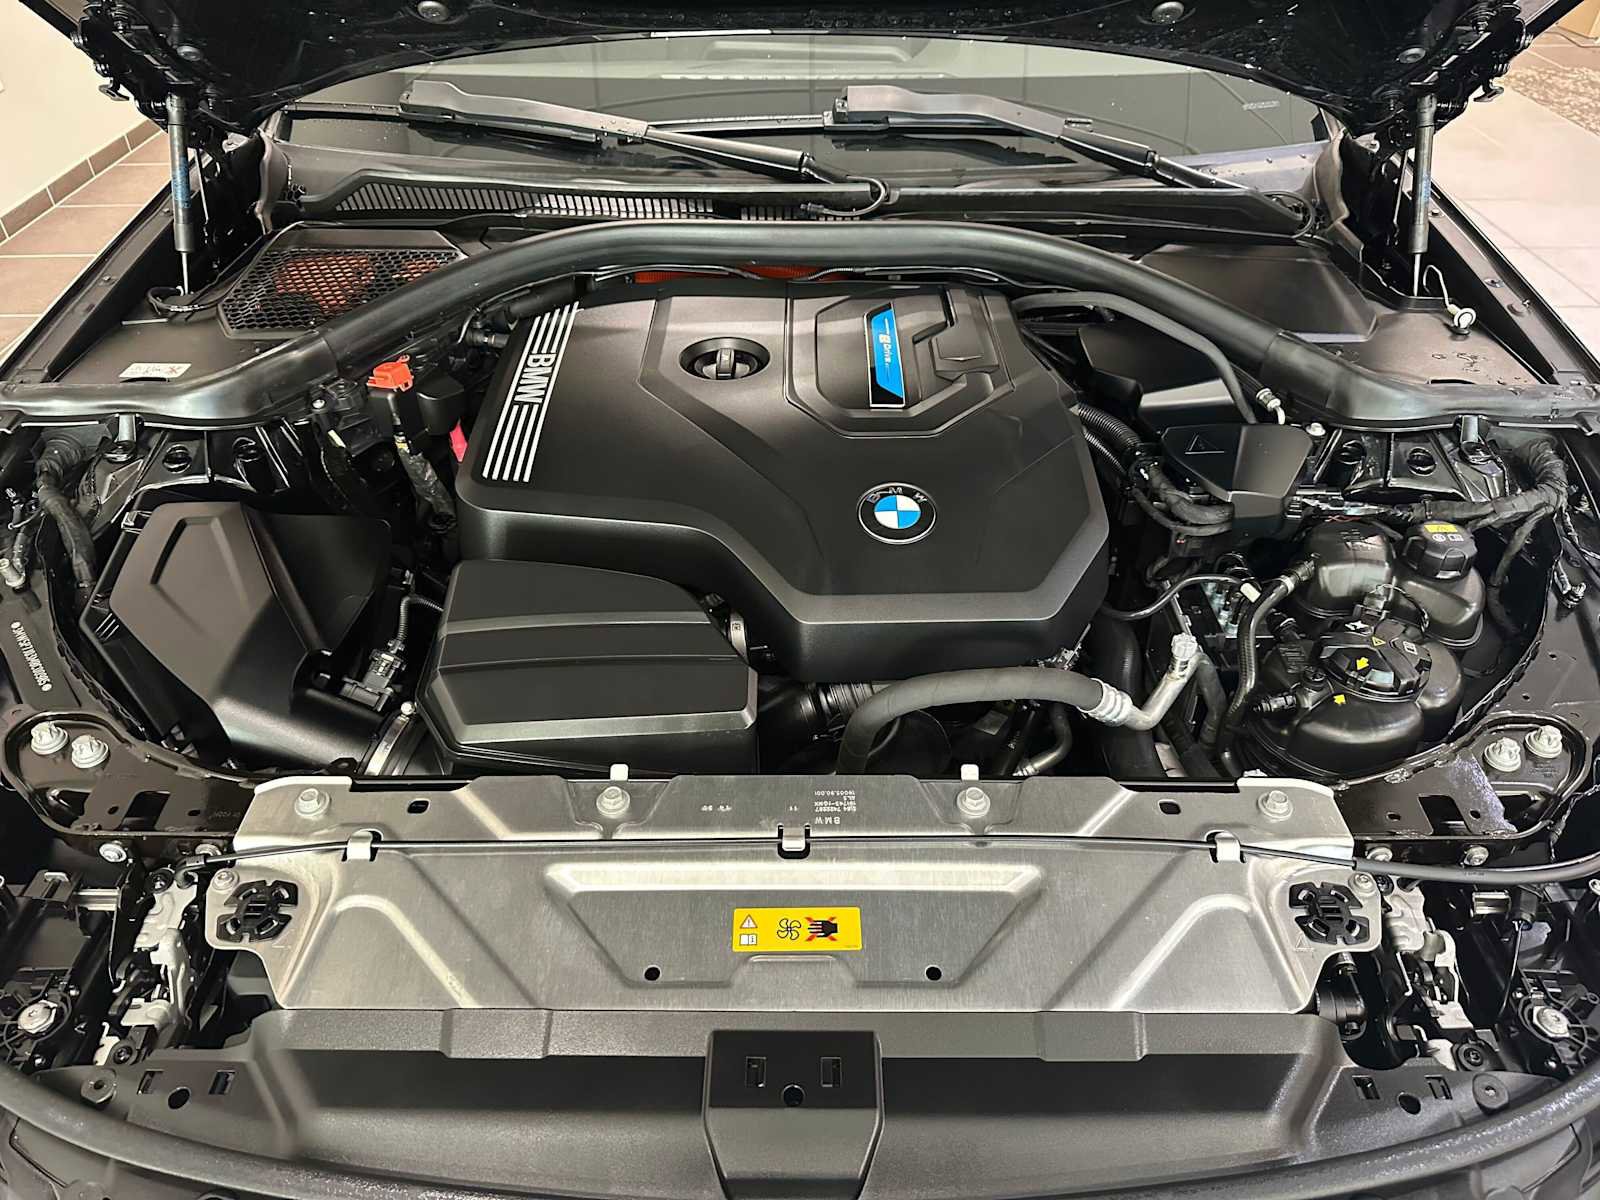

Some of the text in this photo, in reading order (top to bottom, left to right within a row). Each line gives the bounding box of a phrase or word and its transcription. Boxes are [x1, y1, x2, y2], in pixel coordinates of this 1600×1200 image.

[513, 353, 557, 404] BMW
[865, 486, 928, 503] BMW
[814, 816, 841, 825] BMW
